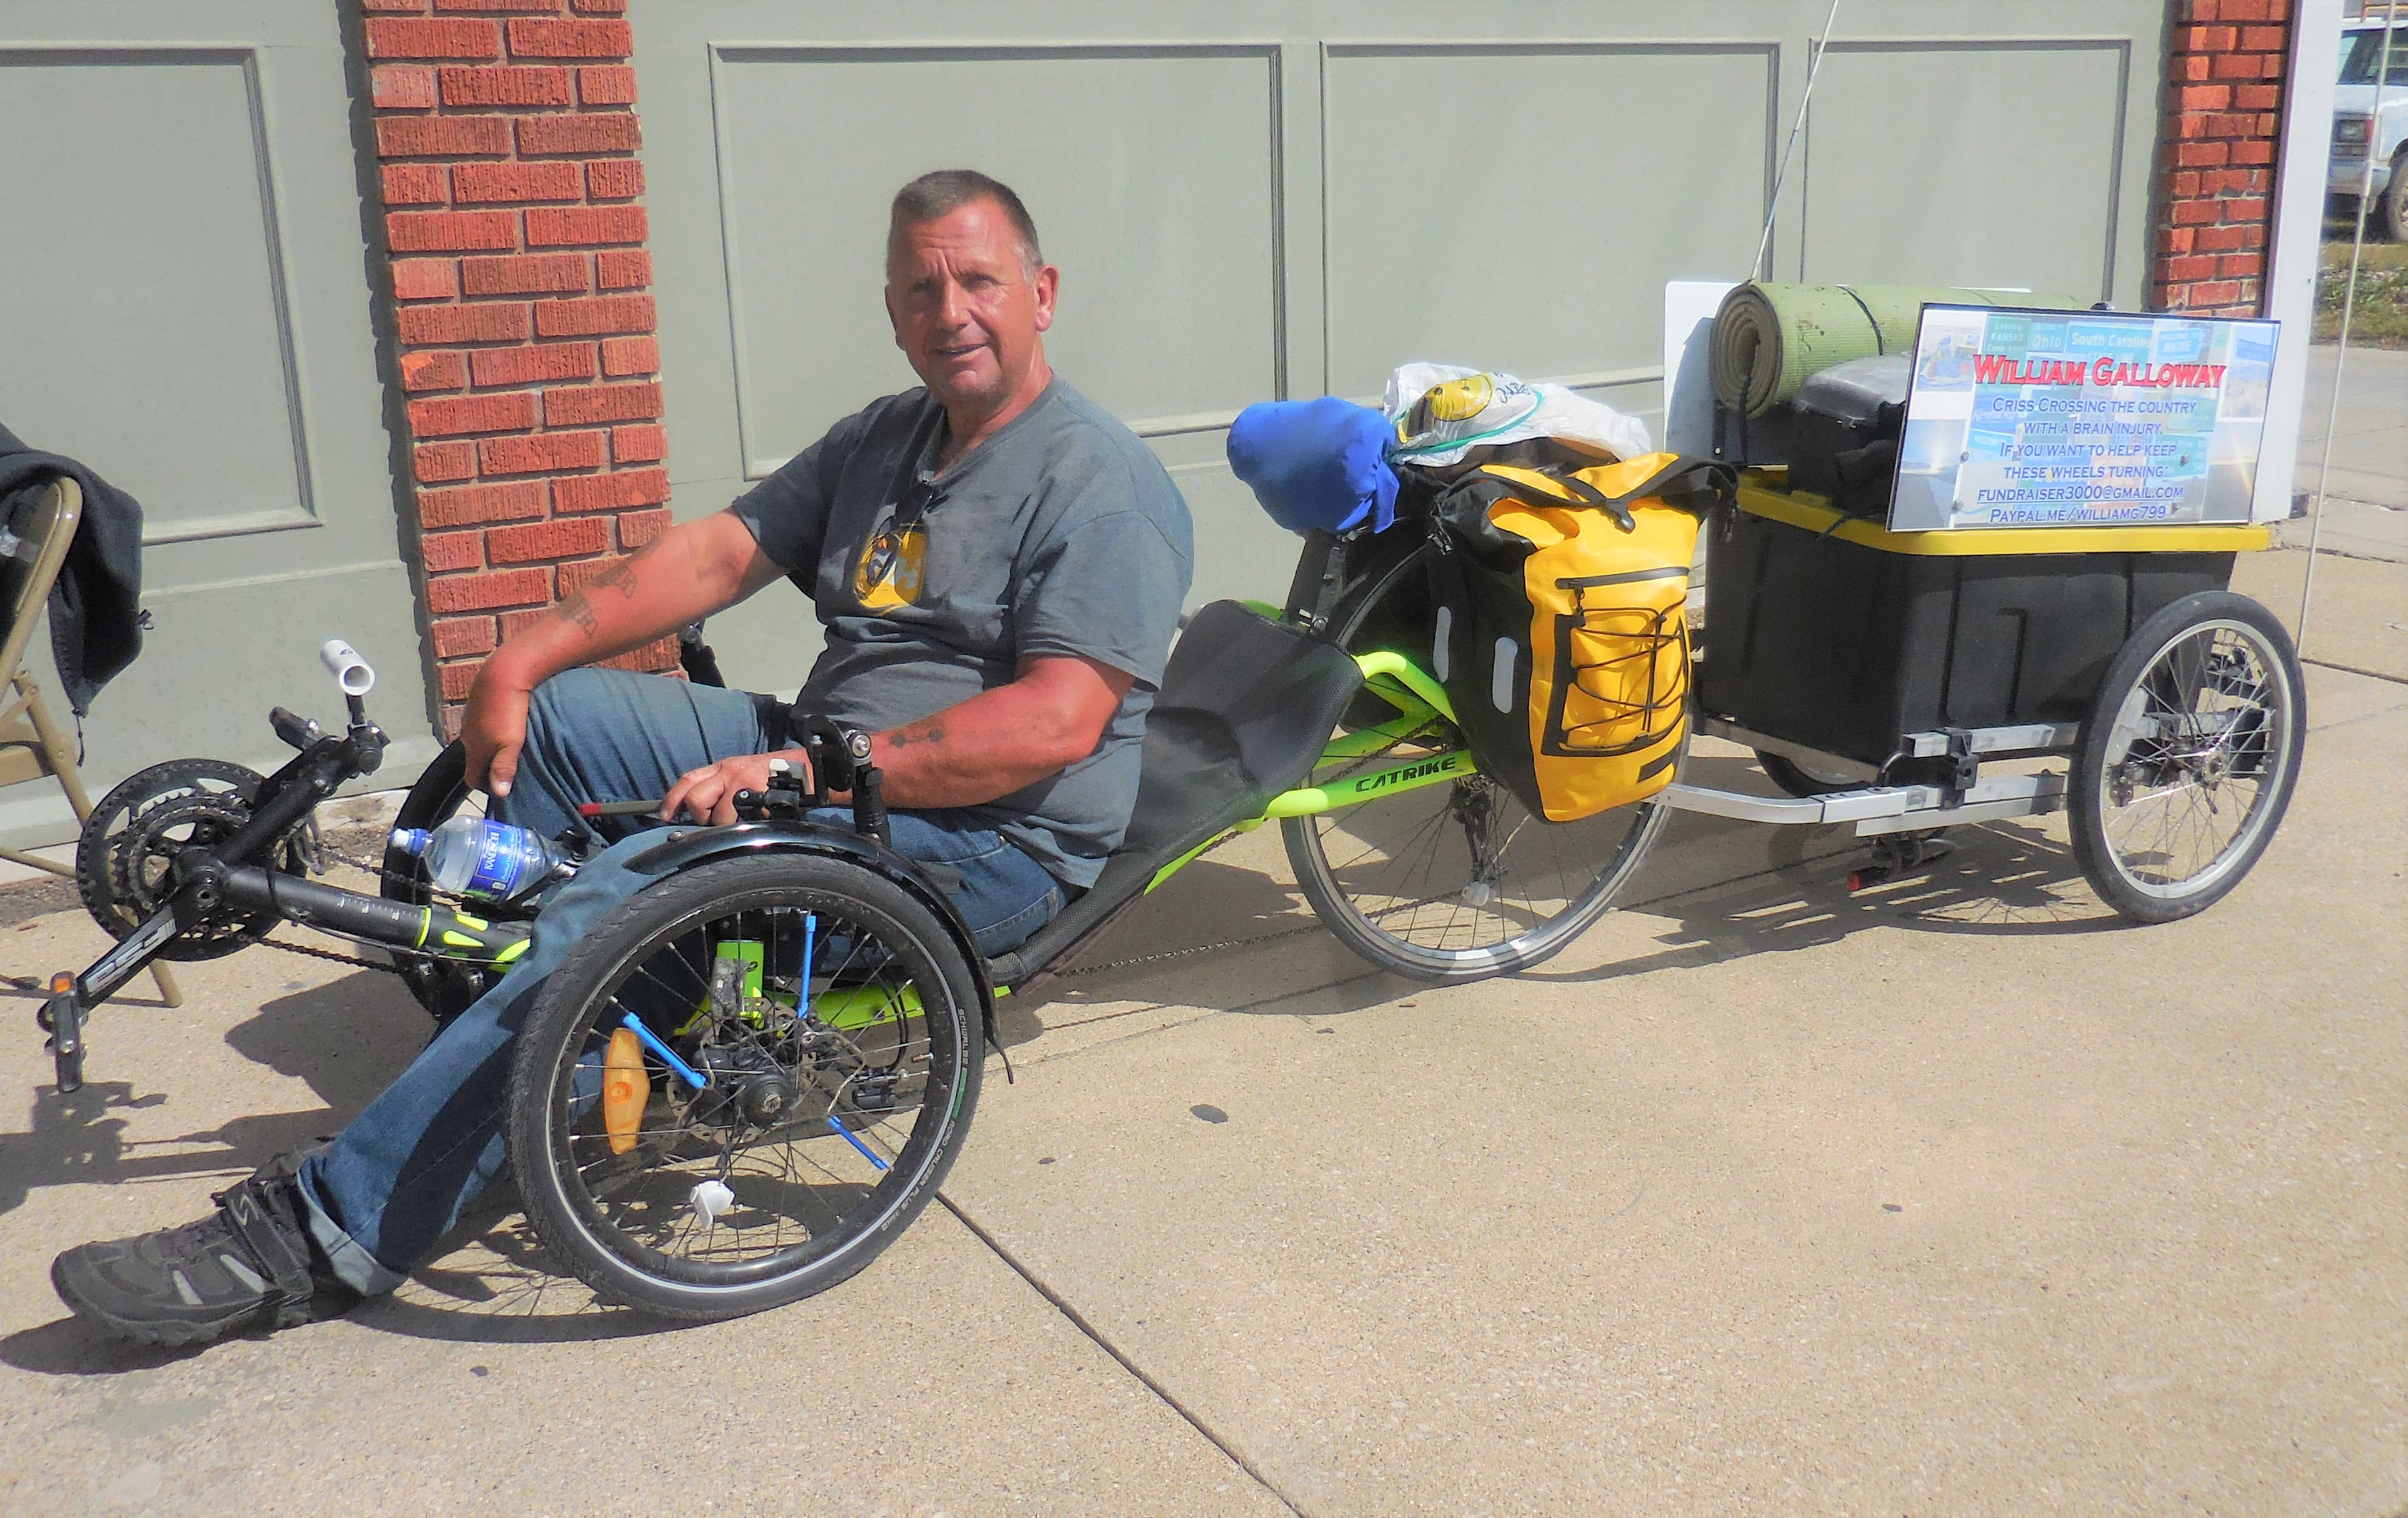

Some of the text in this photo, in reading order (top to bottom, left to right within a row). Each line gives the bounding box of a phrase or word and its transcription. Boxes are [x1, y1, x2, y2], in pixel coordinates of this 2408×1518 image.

[2033, 334, 2061, 349] Ohio
[2072, 332, 2105, 346] South
[1973, 354, 2227, 388] WILLIAM GALLOWAY
[1993, 397, 2197, 414] CRISS CROSSING THE COUNTRY
[2024, 422, 2163, 435] WITH A BRAIN INJURY.
[2000, 442, 2014, 457] IF
[2017, 444, 2043, 457] YOU
[2047, 444, 2085, 457] WANT
[2088, 444, 2105, 457] TO
[2108, 444, 2141, 457] HELP
[2144, 444, 2177, 457] KEEP
[2004, 467, 2047, 479] THESE
[2051, 466, 2105, 479] WHEELS
[1977, 485, 2184, 502] FUNDRAISER3000@GMAIL.COM
[1990, 505, 2167, 522] PAYPAL.ME/WILLIAMG799
[1355, 757, 1456, 793] CATRIKE
[901, 1186, 920, 1211] PLUS
